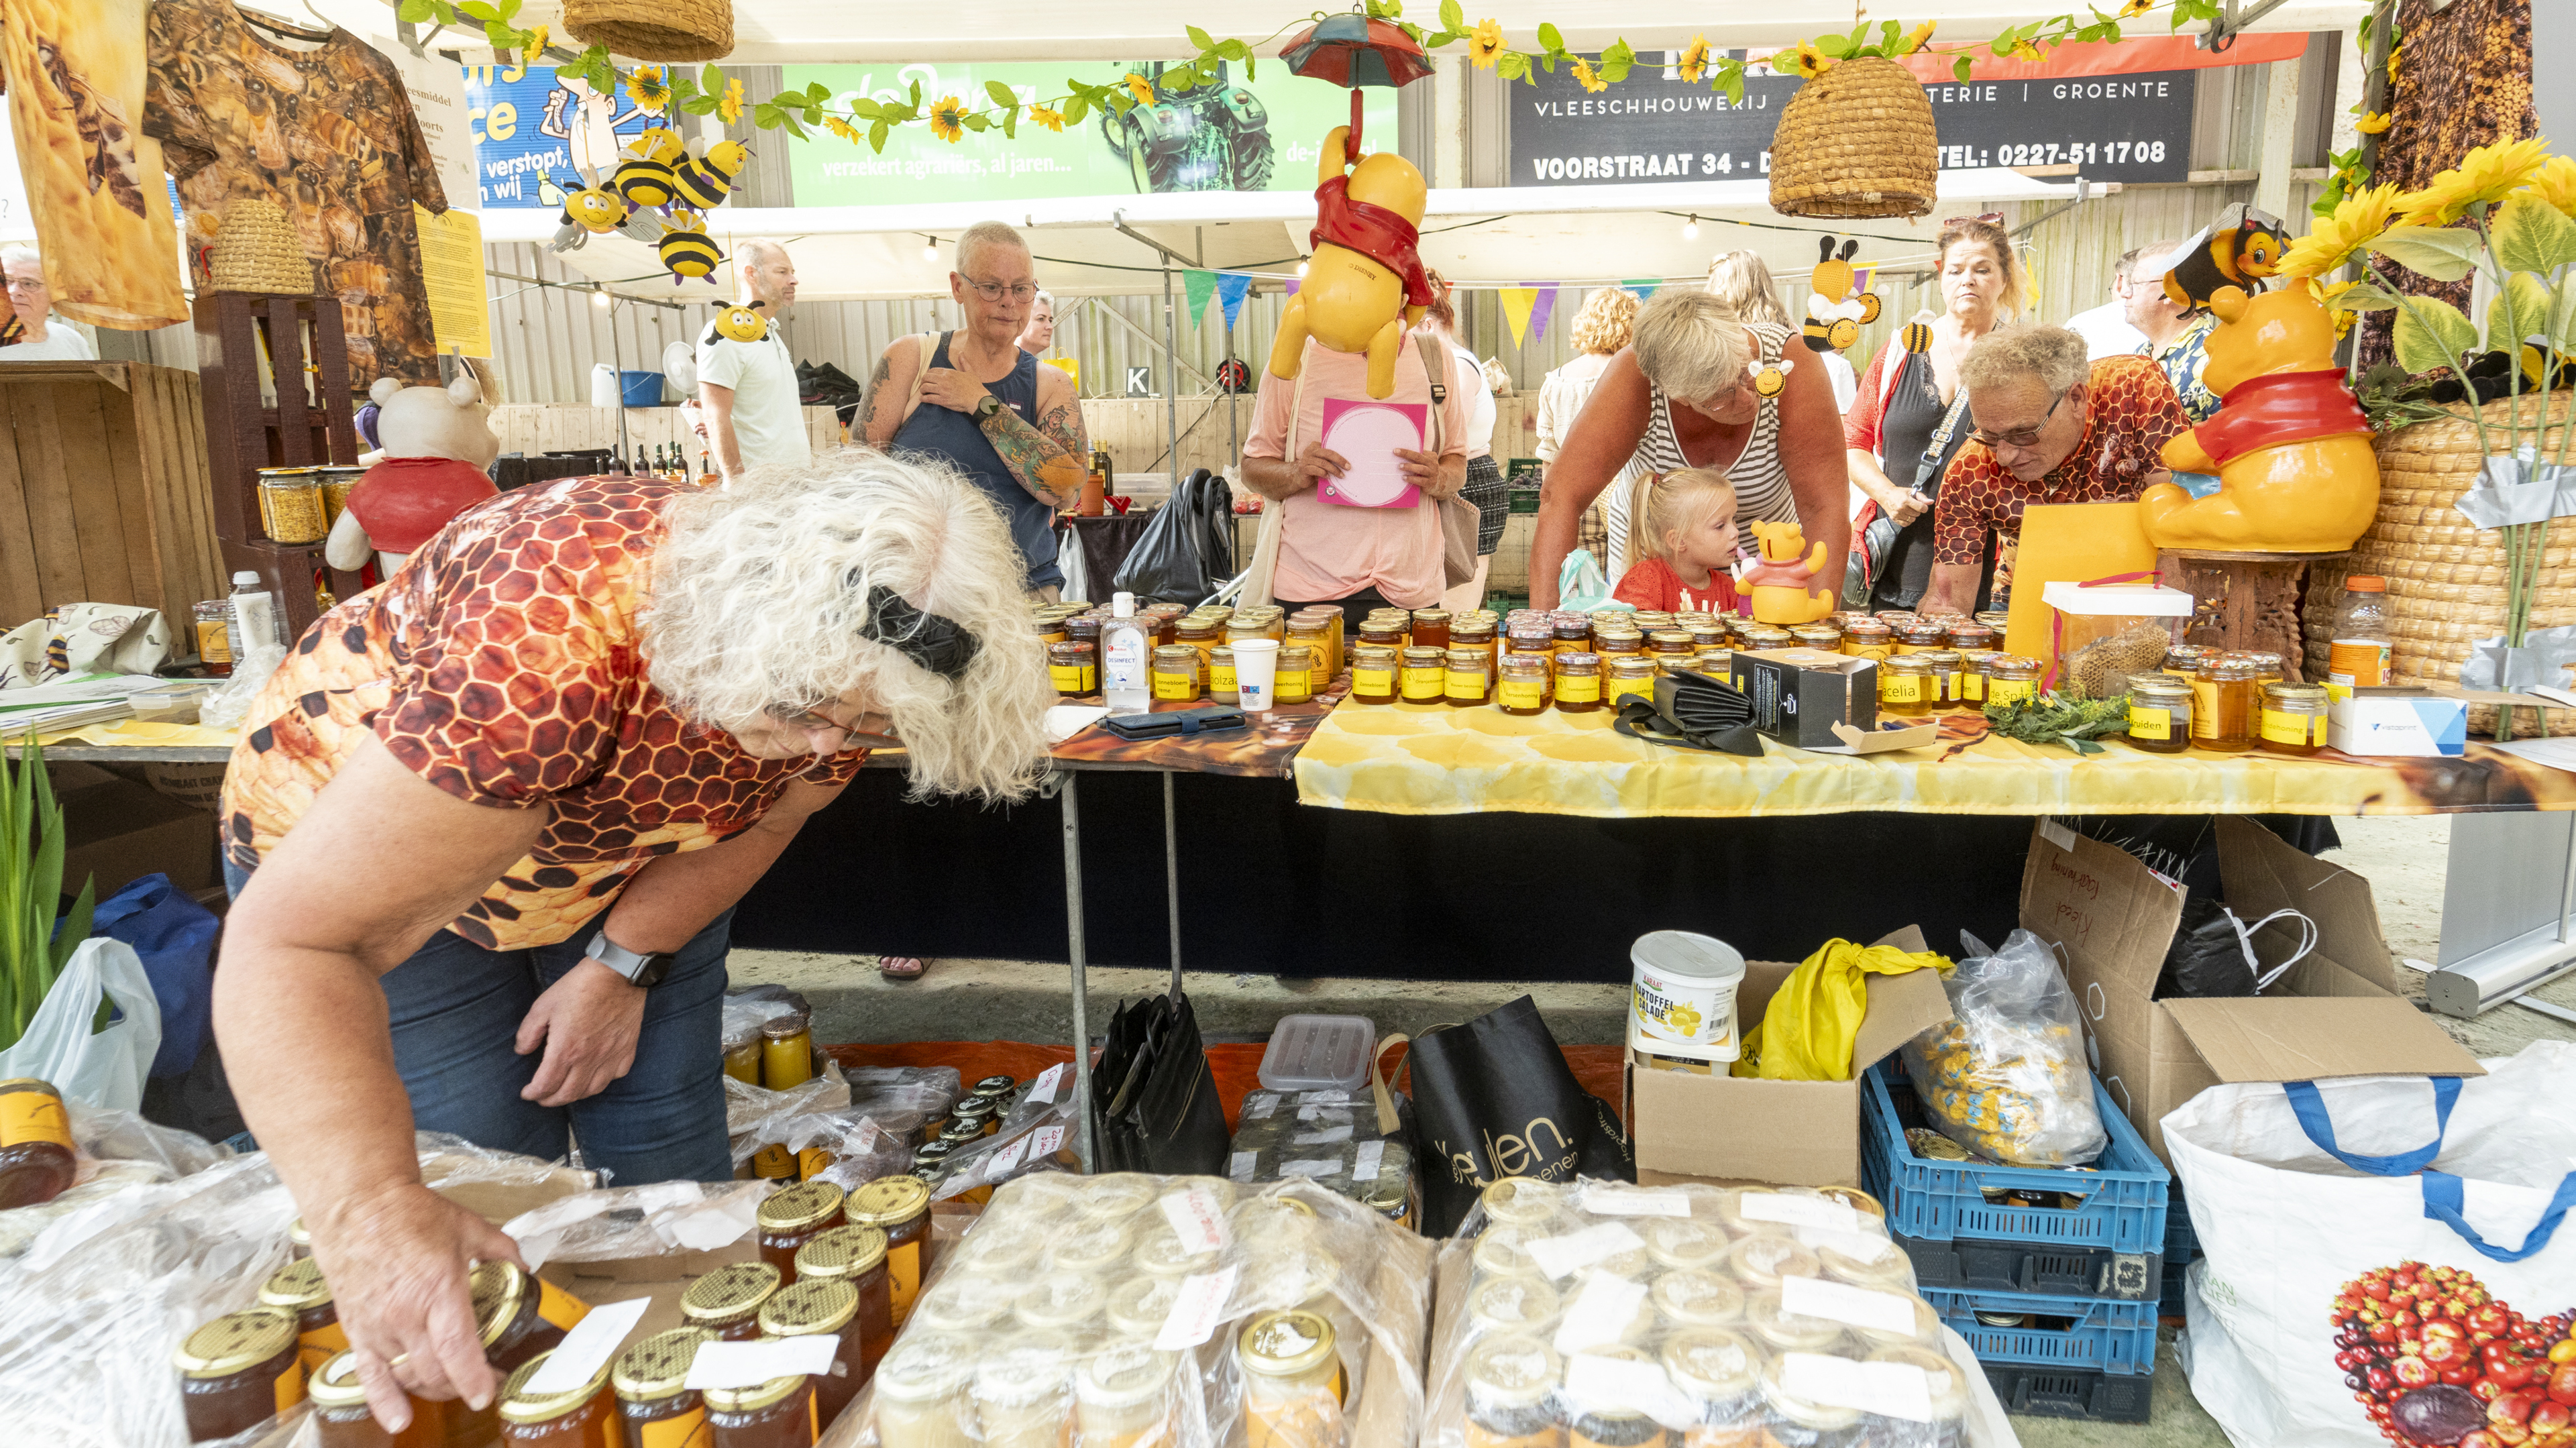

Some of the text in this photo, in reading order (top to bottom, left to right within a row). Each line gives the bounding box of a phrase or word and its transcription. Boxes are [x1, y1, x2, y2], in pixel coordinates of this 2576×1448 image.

[406, 87, 452, 107] eesmiddel
[1926, 82, 2169, 103] TERIE GROENTE
[417, 119, 444, 133] oorts
[486, 146, 568, 179] verstopt,
[822, 152, 1072, 180] verzekert agrariërs, al jaren...
[1534, 154, 1693, 180] VOORSTRAAT
[1702, 153, 1732, 175] 34
[1760, 152, 1772, 173] D
[1937, 145, 1988, 168] TEL:
[493, 174, 522, 201] wij
[1354, 265, 1377, 280] DISNEY
[1127, 368, 1148, 393] K
[1210, 675, 1238, 685] oolzaa
[1882, 684, 1915, 697] acelia
[2131, 719, 2161, 730] Kruiden
[1644, 974, 1663, 989] KARAAT
[1635, 981, 1675, 1011] KARTOFFEL
[1638, 997, 1666, 1020] SALADE
